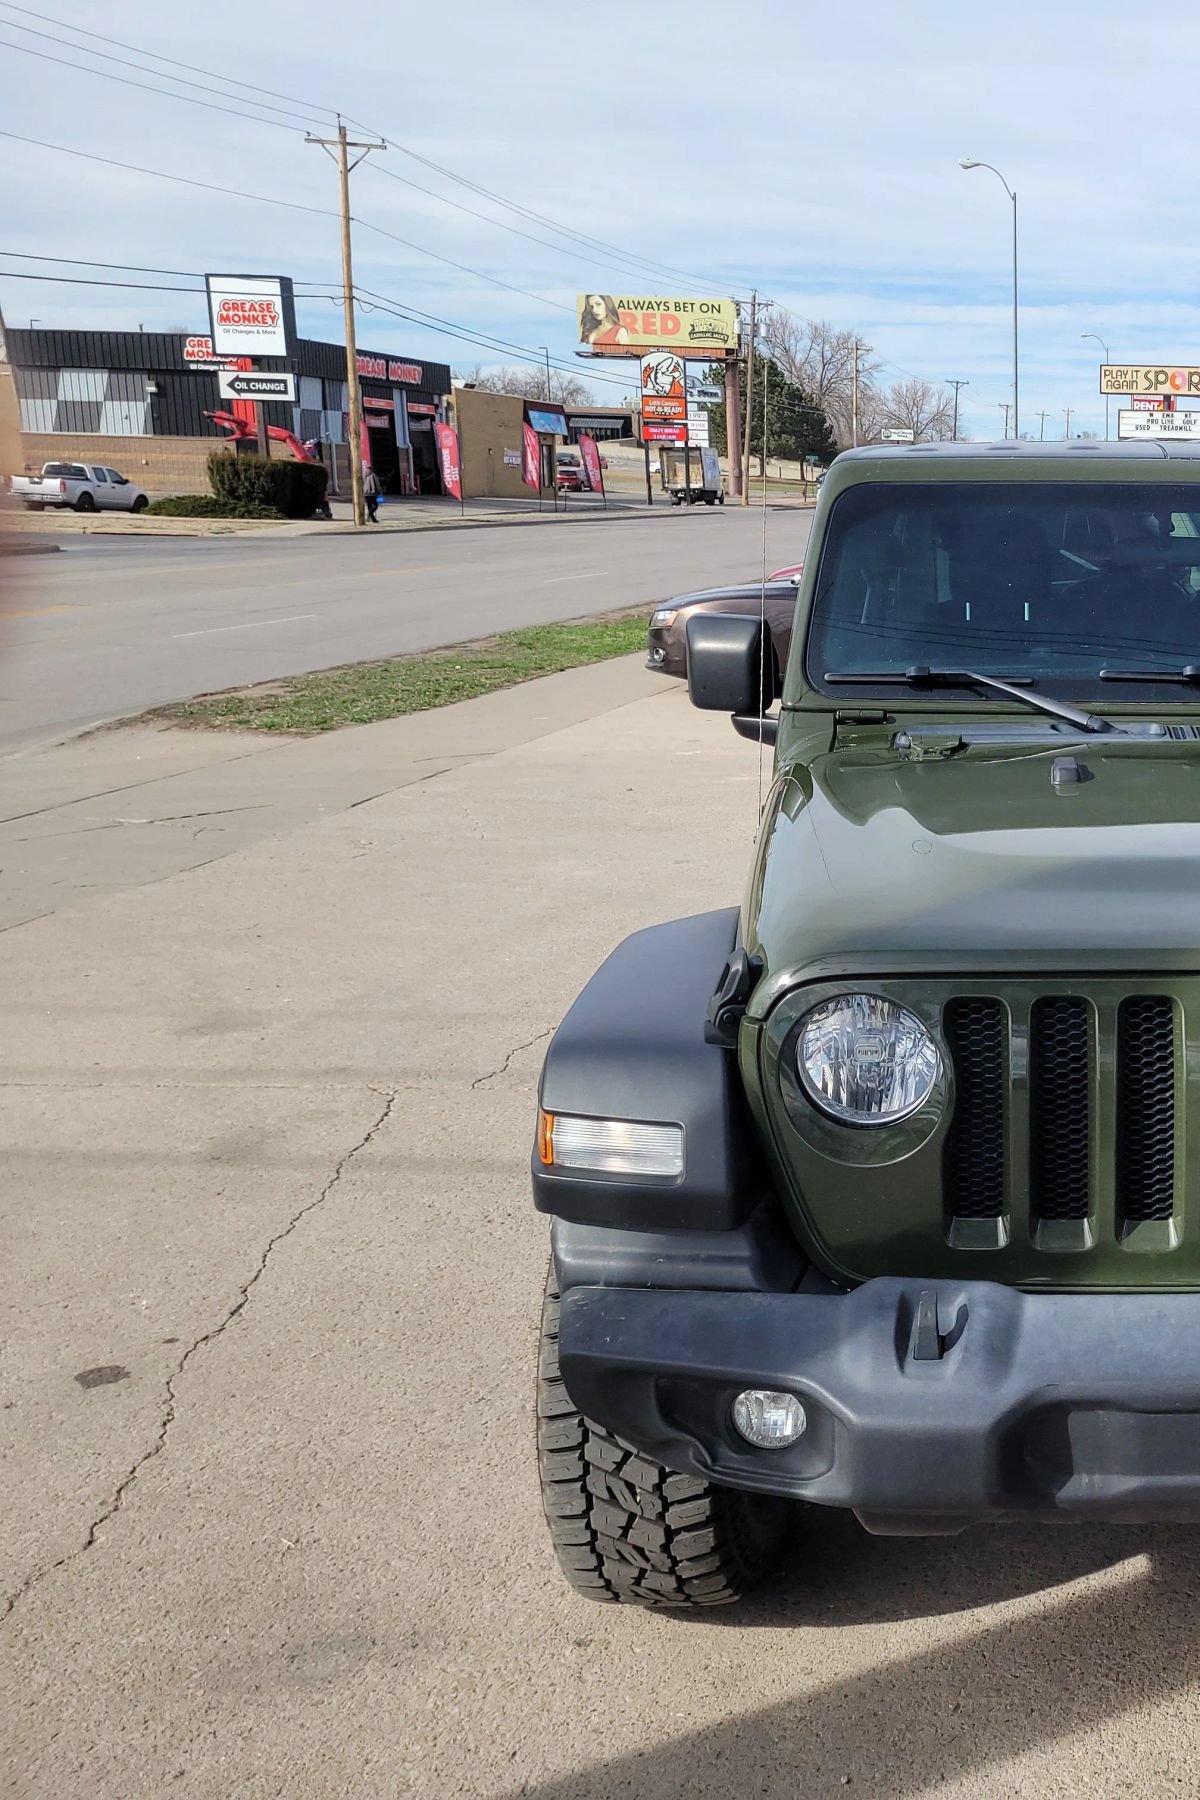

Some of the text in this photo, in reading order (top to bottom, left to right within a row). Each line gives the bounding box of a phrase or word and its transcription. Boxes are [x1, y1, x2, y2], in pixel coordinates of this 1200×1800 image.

[221, 301, 275, 313] GREASE
[617, 300, 721, 314] ALWAYS BET ON
[219, 313, 277, 325] MONKEY
[619, 312, 681, 336] RED
[187, 338, 211, 349] GRE
[389, 361, 422, 384] MONKEY
[1103, 369, 1140, 380] PLAY IT
[234, 382, 285, 391] OIL CHANGE
[1106, 379, 1139, 390] AGAIN
[1133, 401, 1160, 411] RENT
